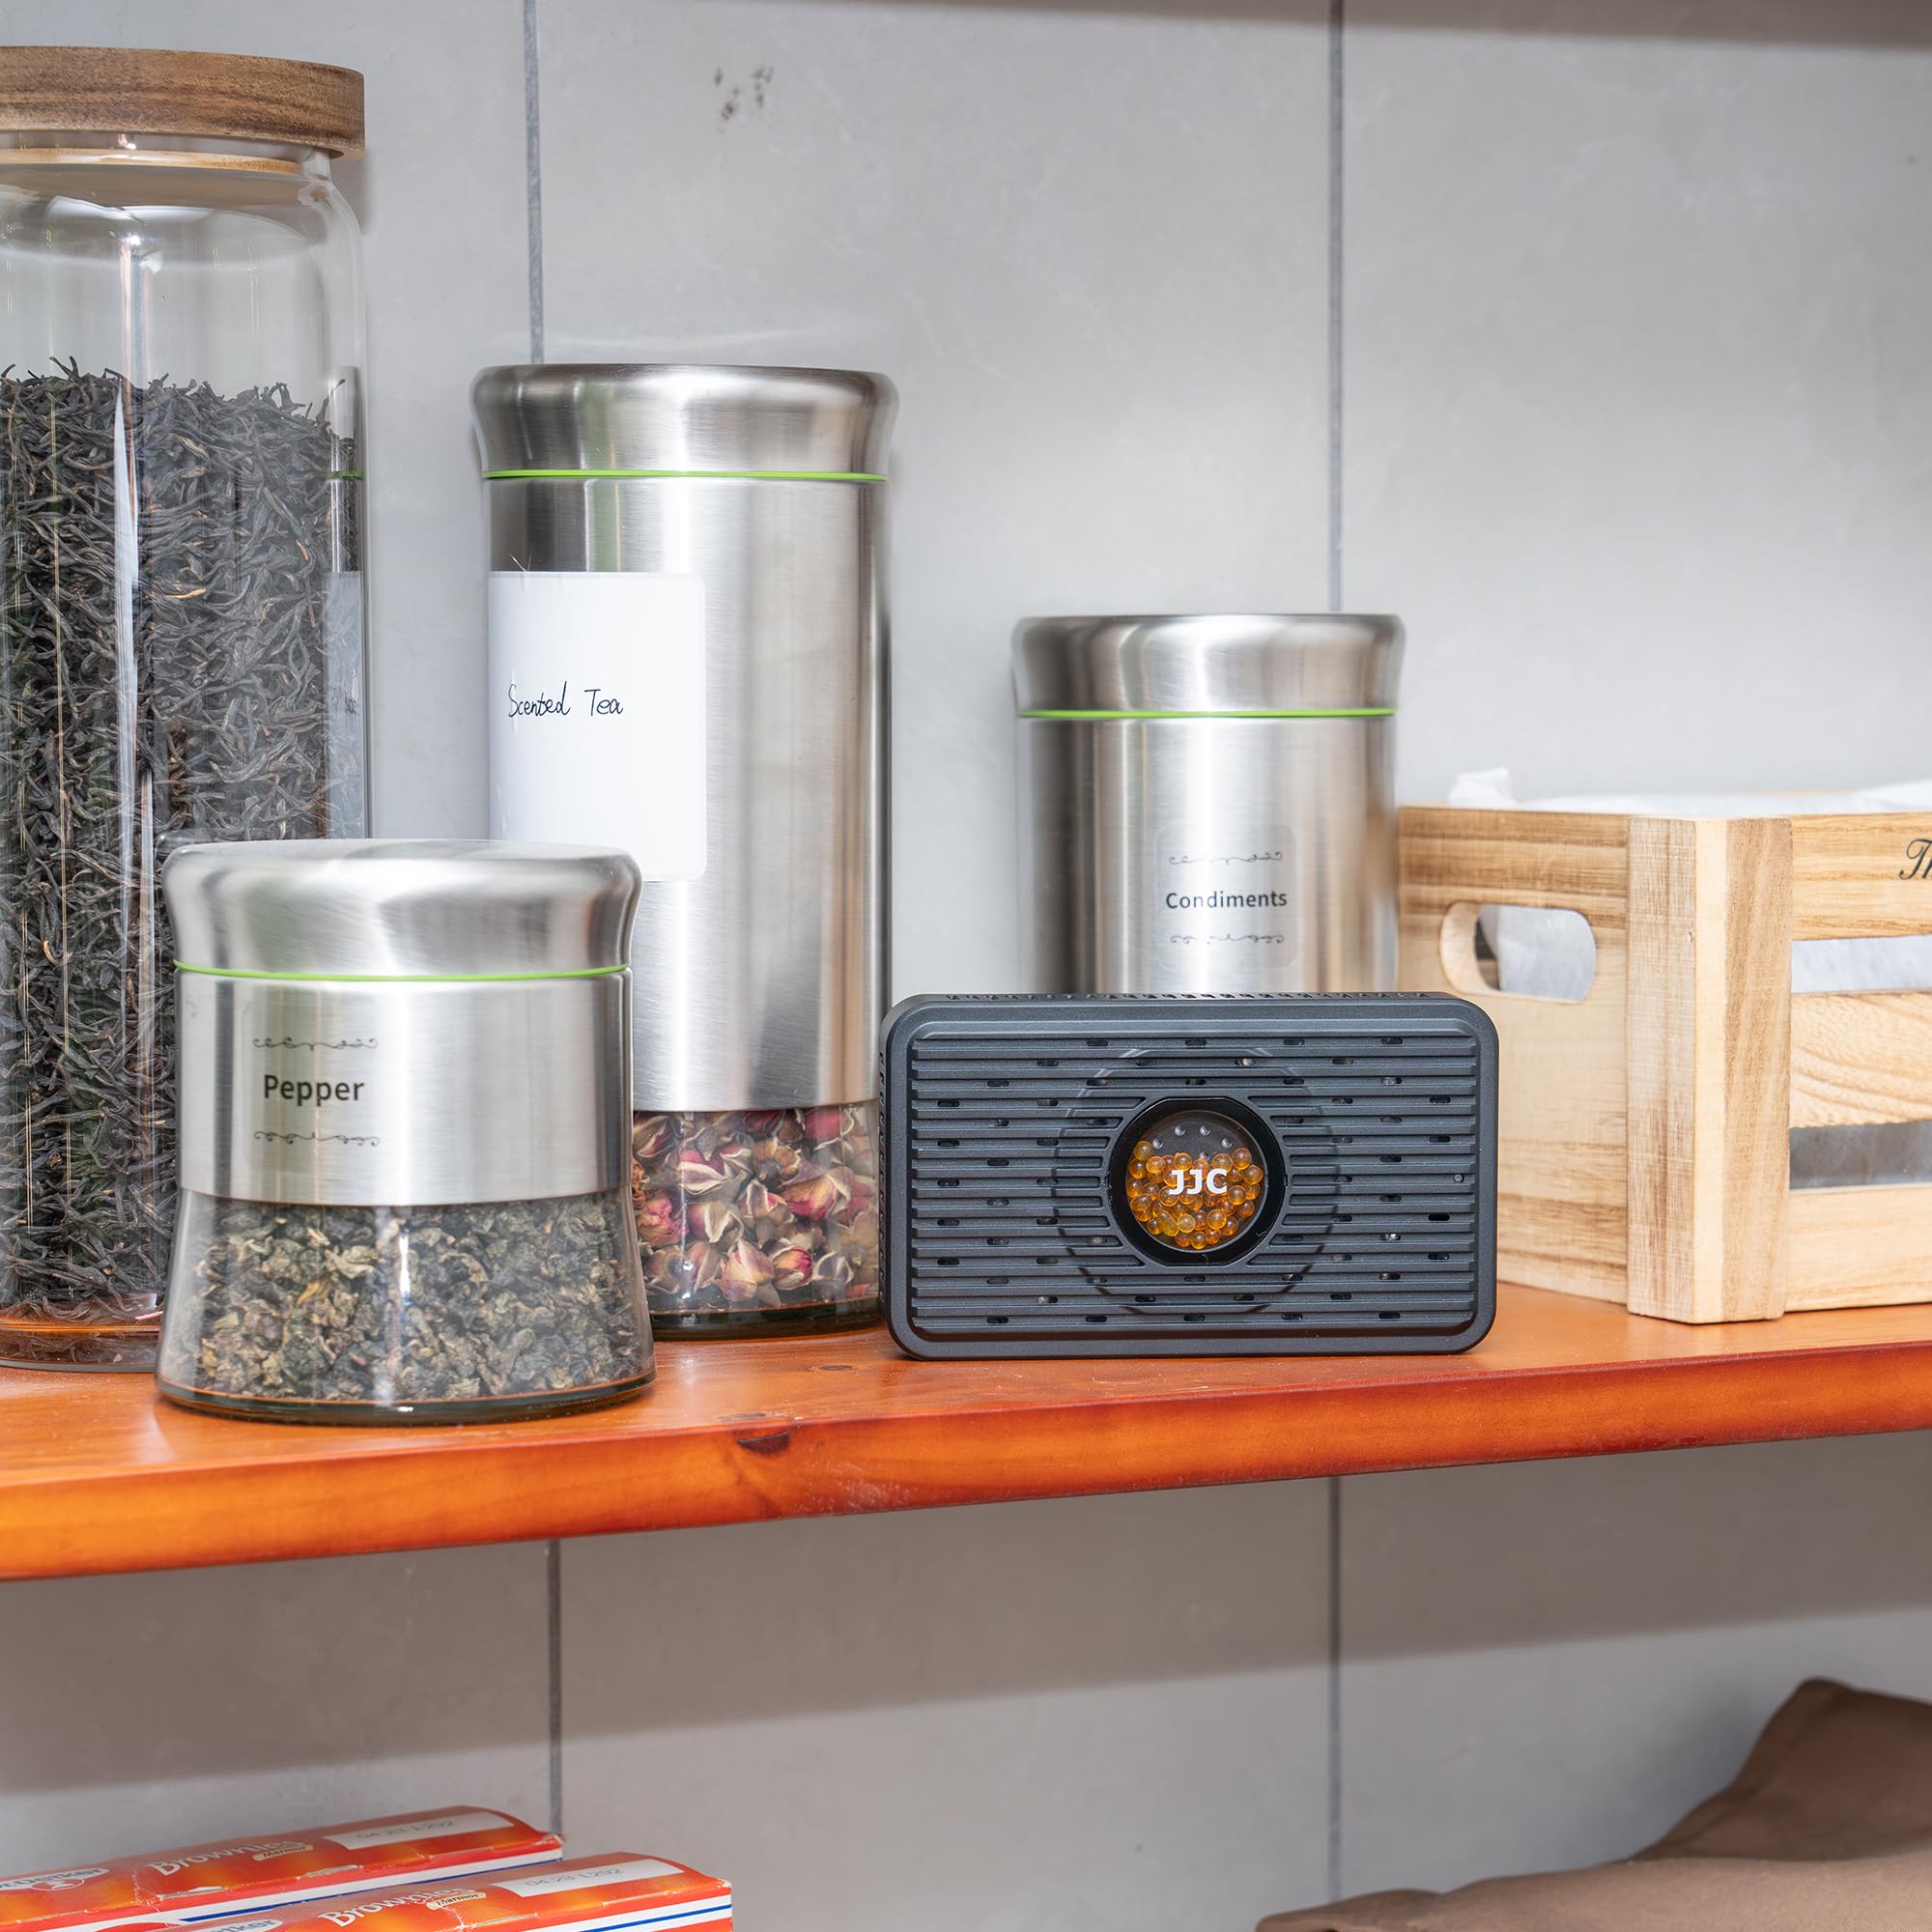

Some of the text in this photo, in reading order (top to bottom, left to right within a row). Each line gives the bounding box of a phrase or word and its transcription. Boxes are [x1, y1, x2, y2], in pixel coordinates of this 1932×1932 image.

[508, 681, 624, 717] Scented Tea
[1166, 891, 1288, 909] Condiments
[264, 1074, 365, 1107] Pepper
[1169, 1168, 1228, 1195] JJC
[318, 1888, 476, 1927] Brownies
